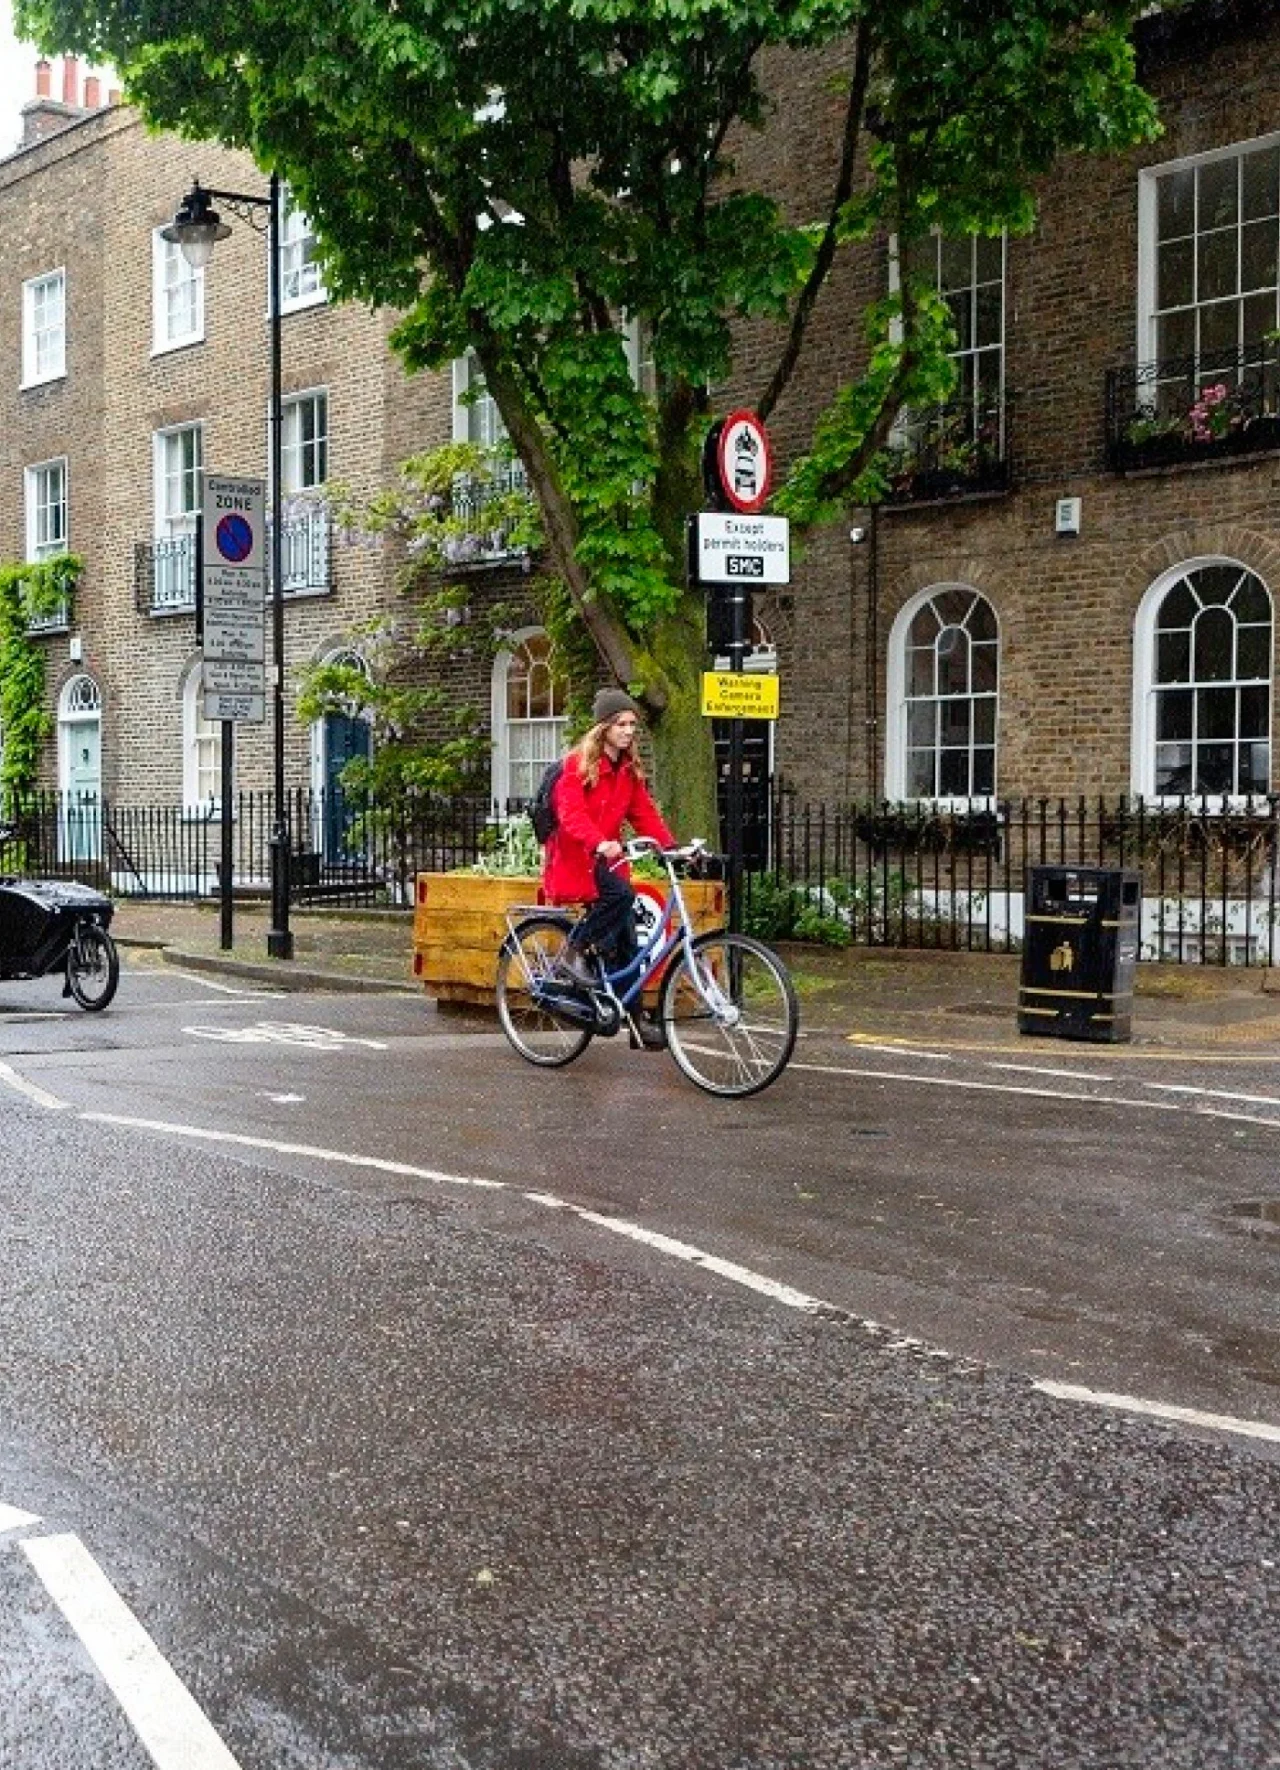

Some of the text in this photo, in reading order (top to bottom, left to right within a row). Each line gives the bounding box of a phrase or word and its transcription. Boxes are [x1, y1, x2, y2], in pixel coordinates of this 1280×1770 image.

[216, 494, 252, 511] ZONE
[725, 520, 764, 535] Except
[704, 537, 785, 552] permit holders
[729, 557, 762, 576] SMC
[720, 689, 762, 701] Camera
[706, 700, 774, 713] Enforcement
